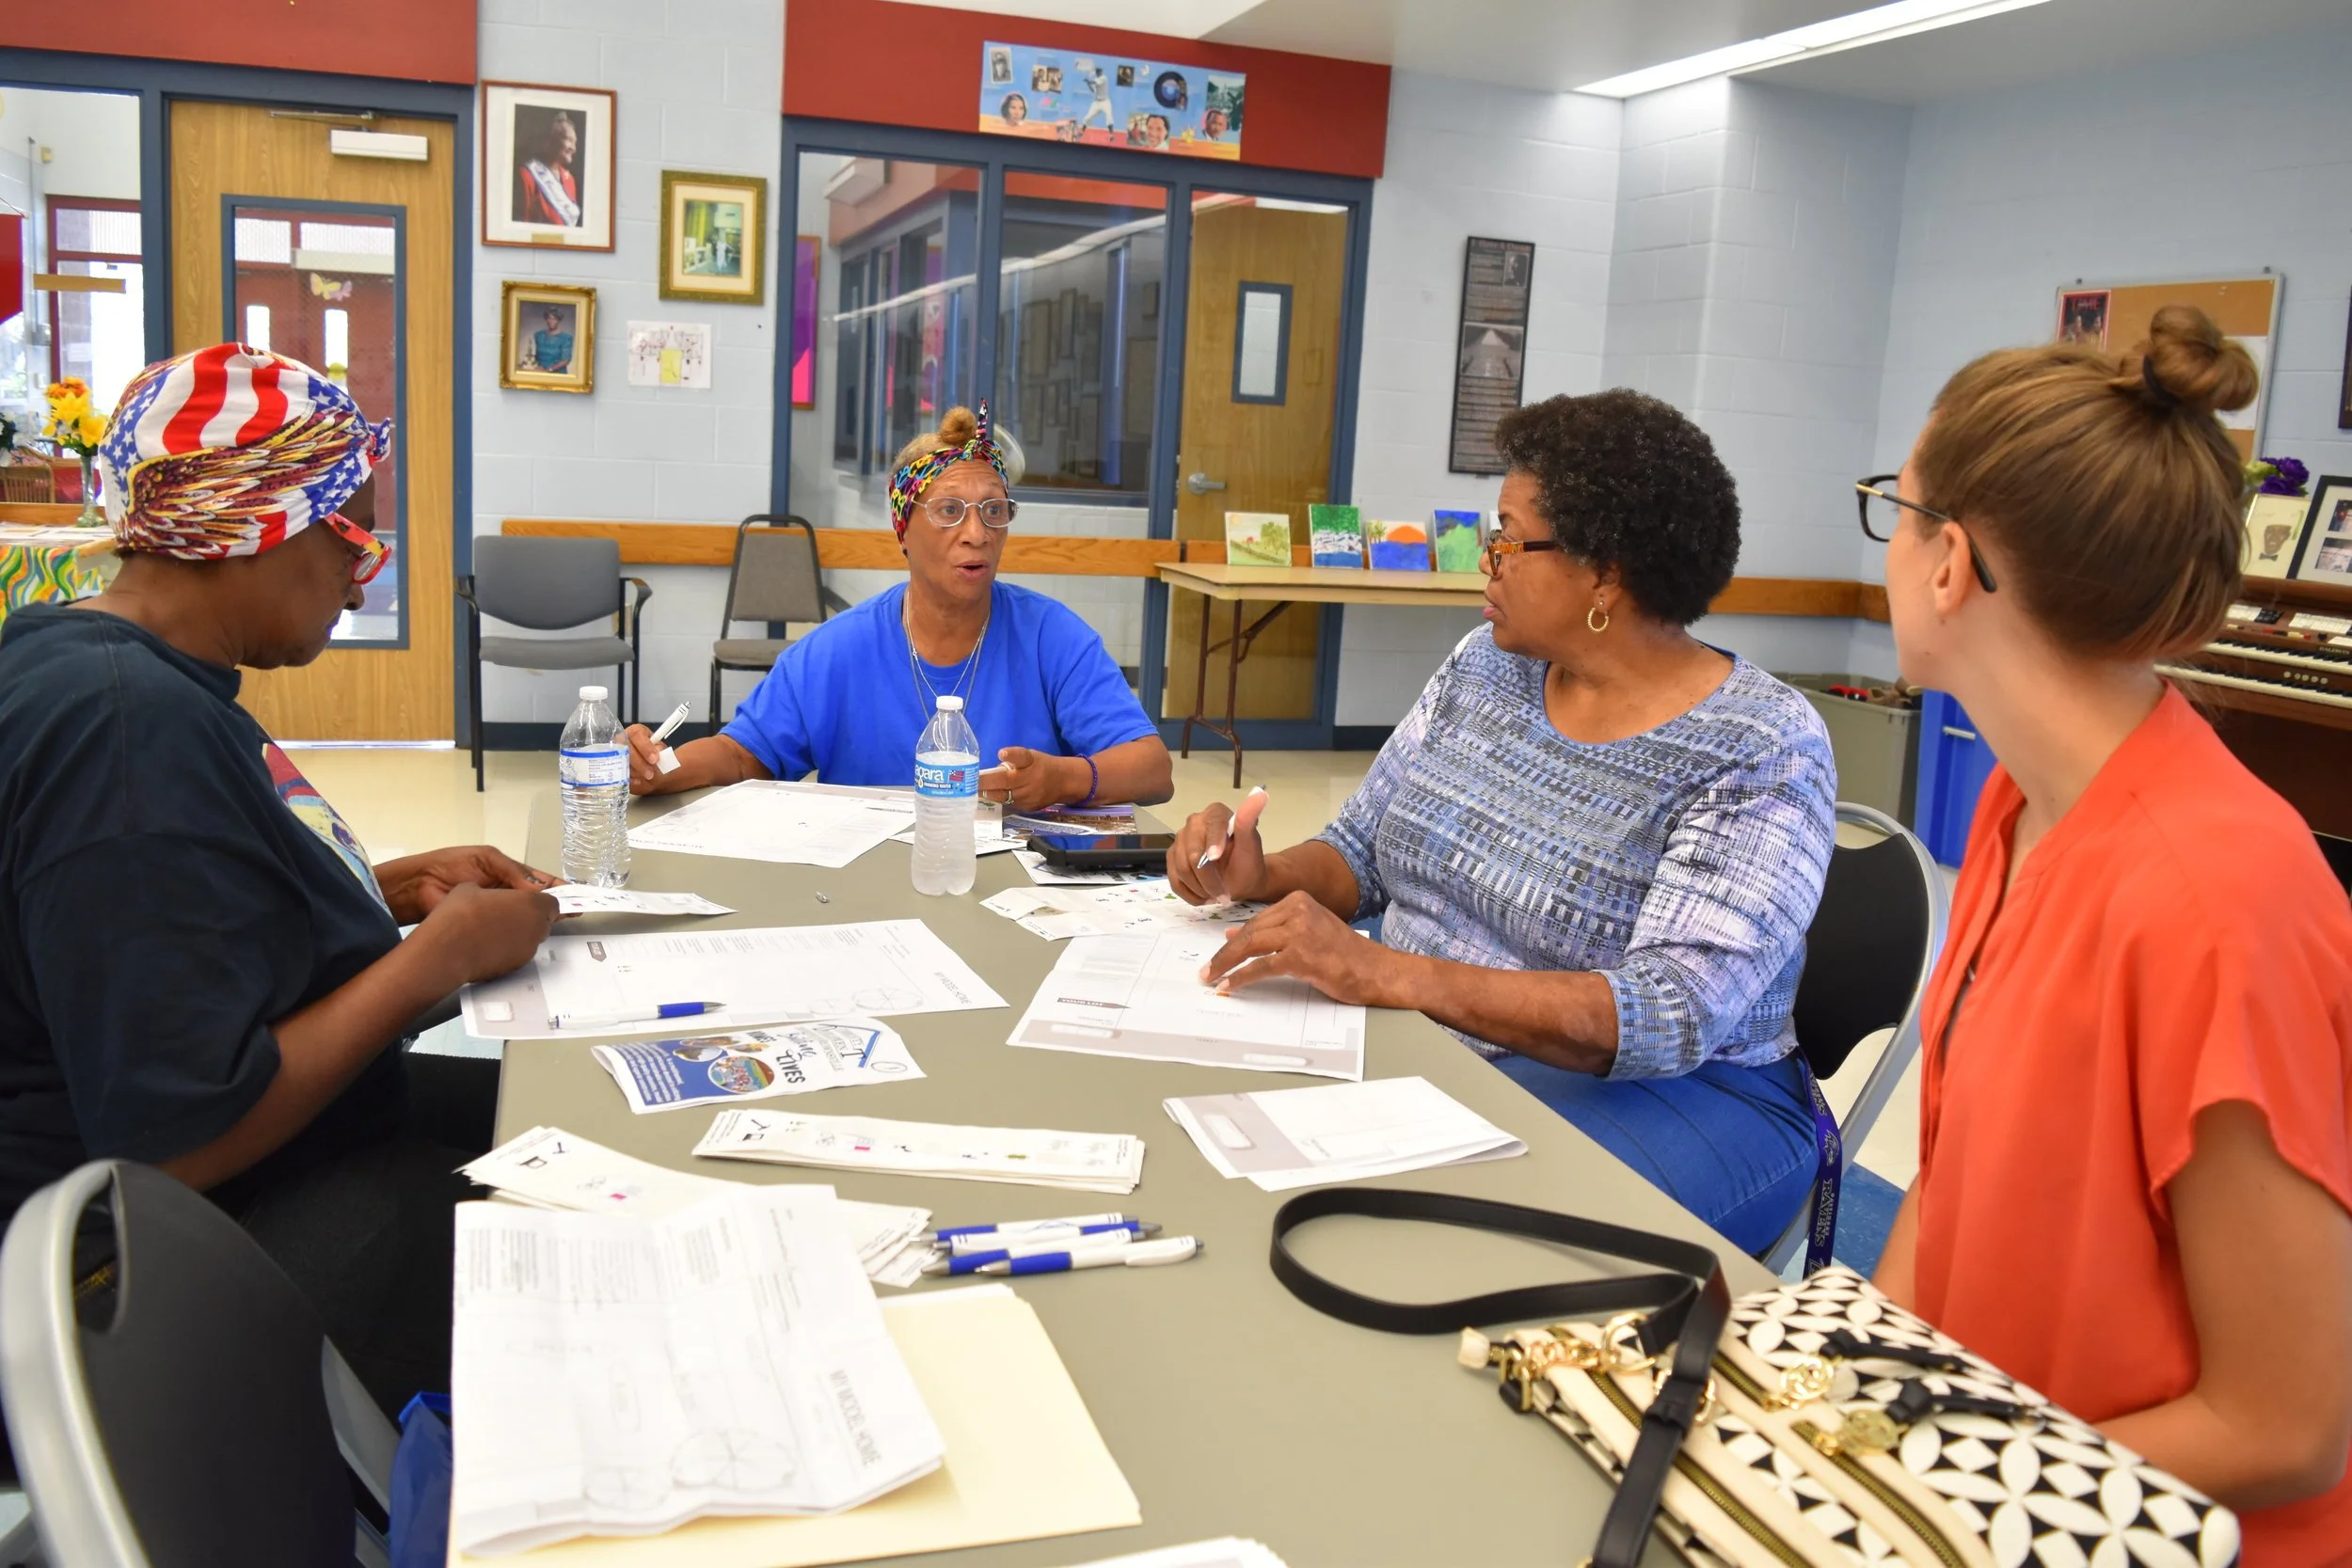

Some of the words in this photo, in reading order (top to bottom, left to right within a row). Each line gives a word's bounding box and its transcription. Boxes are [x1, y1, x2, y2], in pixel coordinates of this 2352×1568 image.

[915, 764, 944, 783] agara
[775, 1049, 806, 1084] LIVES
[1814, 1178, 1834, 1248] RAVENS
[856, 1430, 883, 1468] HOME
